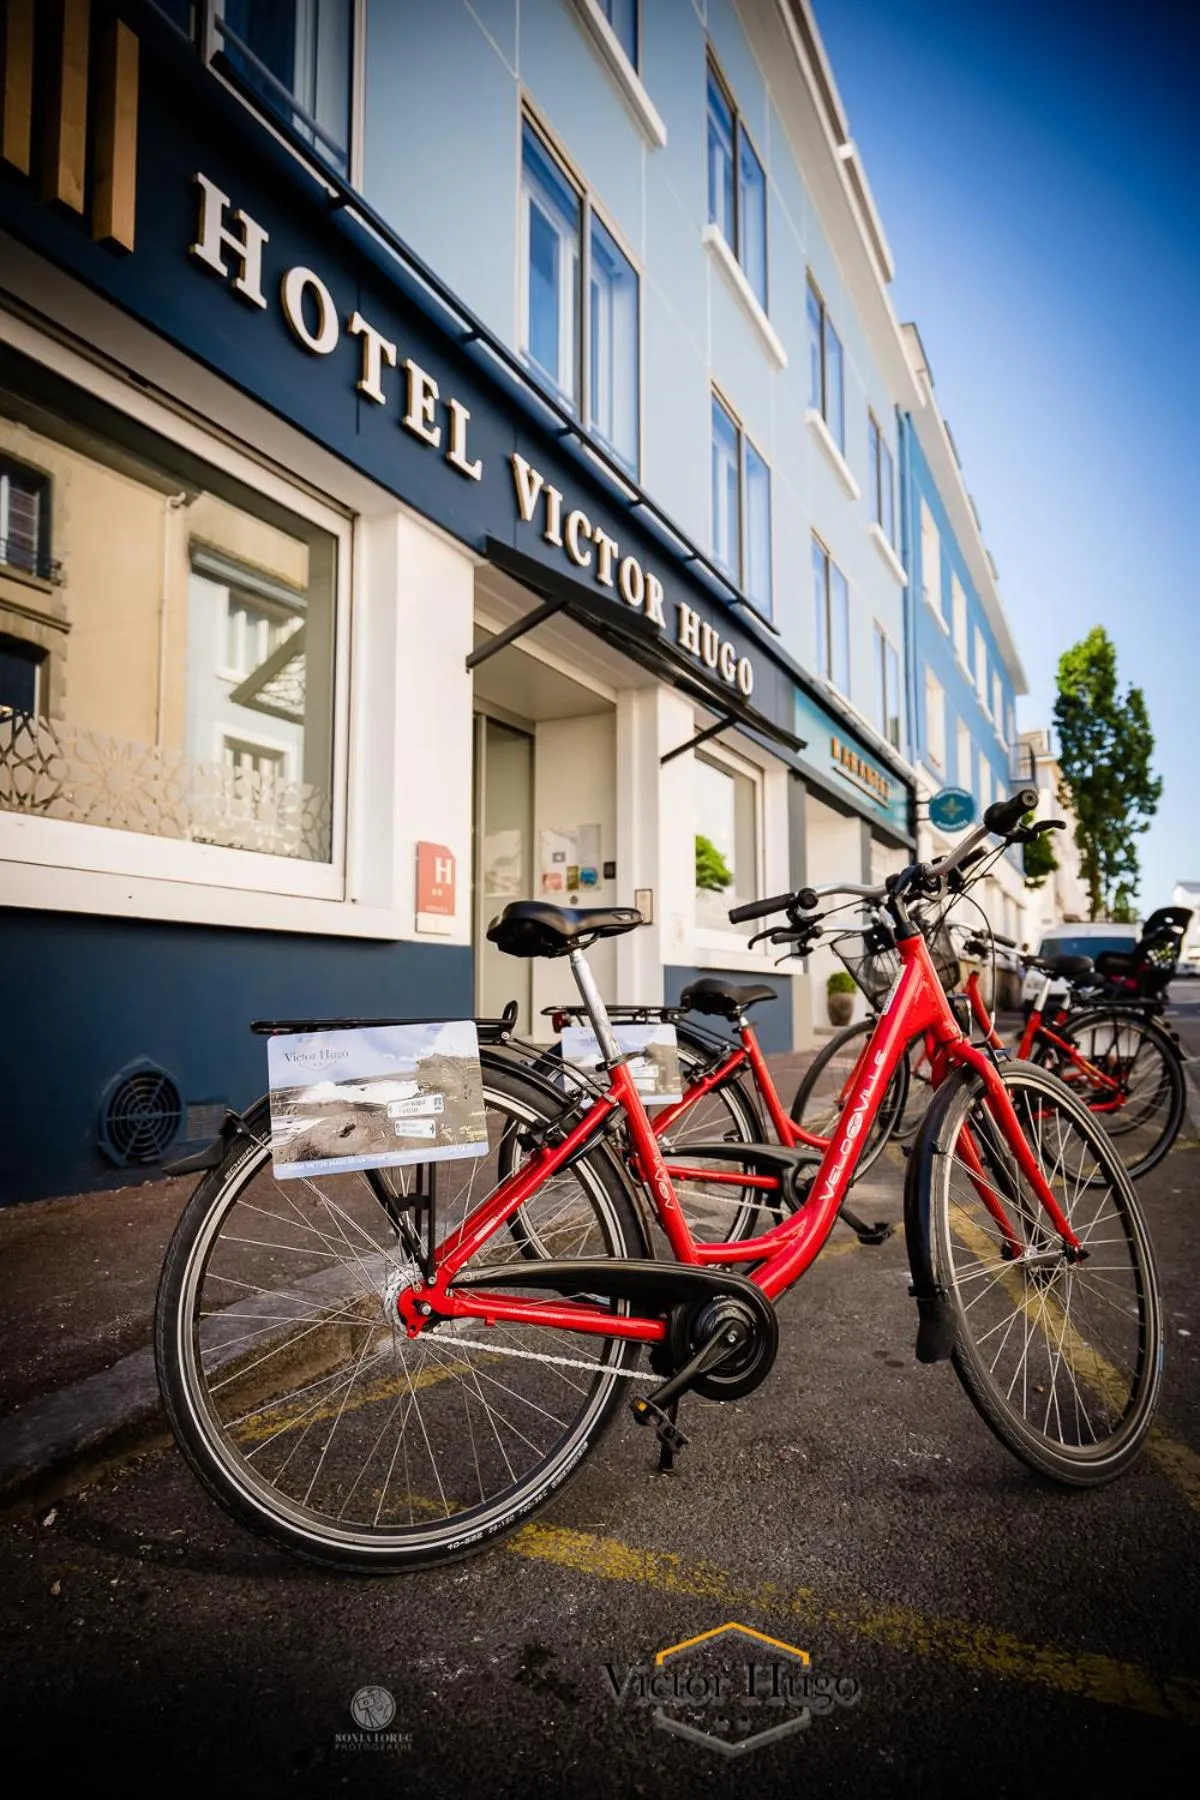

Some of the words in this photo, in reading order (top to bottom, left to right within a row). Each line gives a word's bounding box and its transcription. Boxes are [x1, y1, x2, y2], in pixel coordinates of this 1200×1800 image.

[190, 172, 482, 481] HOTEL
[510, 452, 667, 629] VICTOR
[676, 601, 755, 697] HUGO
[435, 856, 452, 885] H
